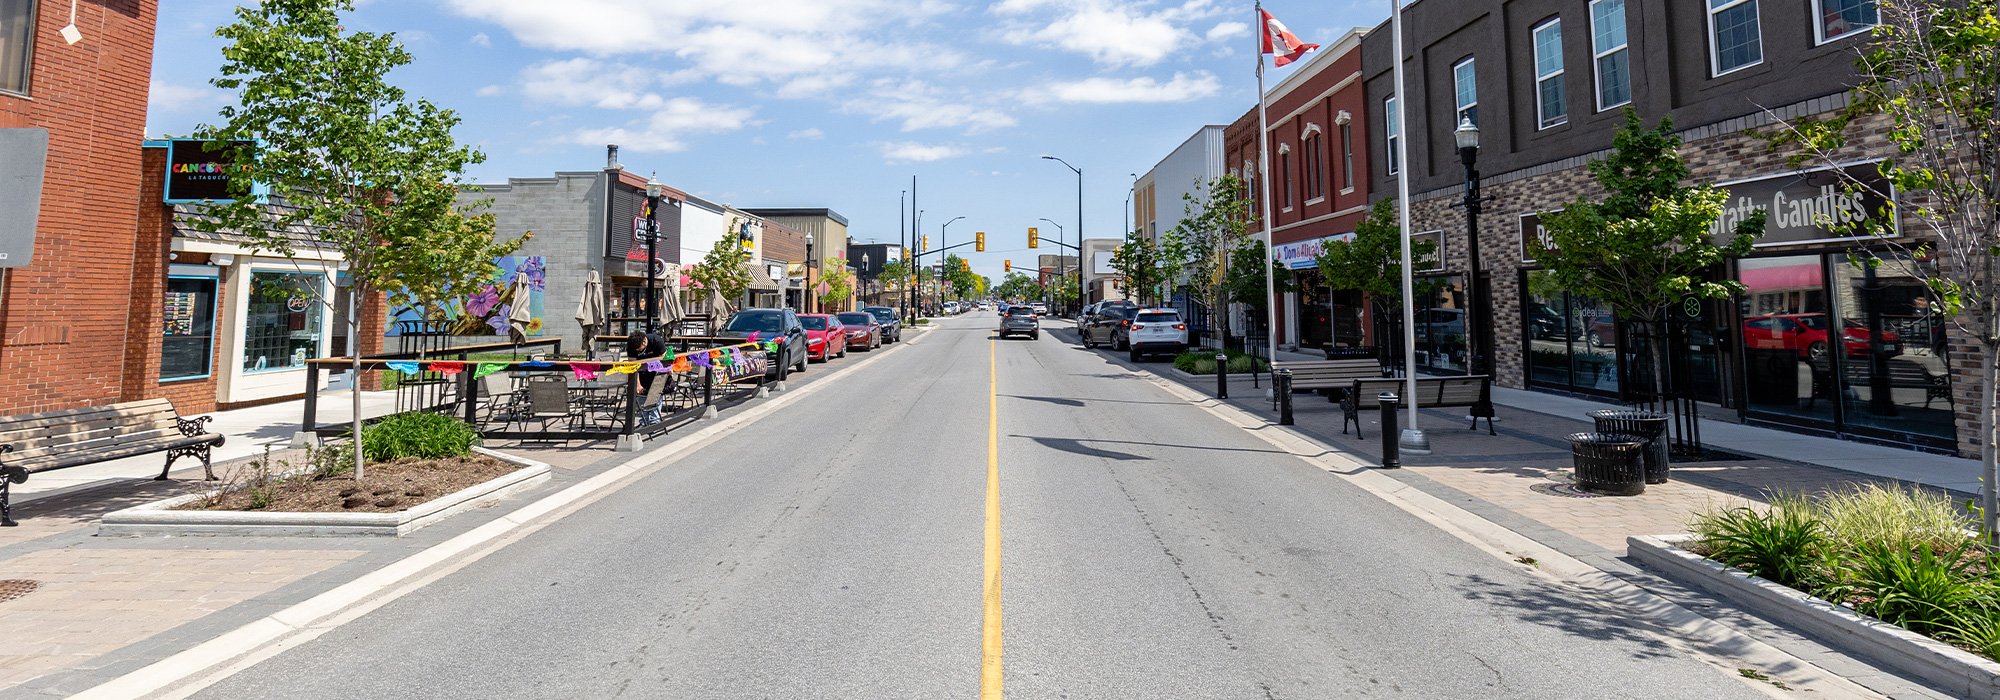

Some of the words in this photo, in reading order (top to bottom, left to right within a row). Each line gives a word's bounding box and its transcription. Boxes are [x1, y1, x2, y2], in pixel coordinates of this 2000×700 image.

[1773, 184, 1865, 229] Candles
[1283, 245, 1297, 260] Dom
[288, 298, 309, 308] OPEN
